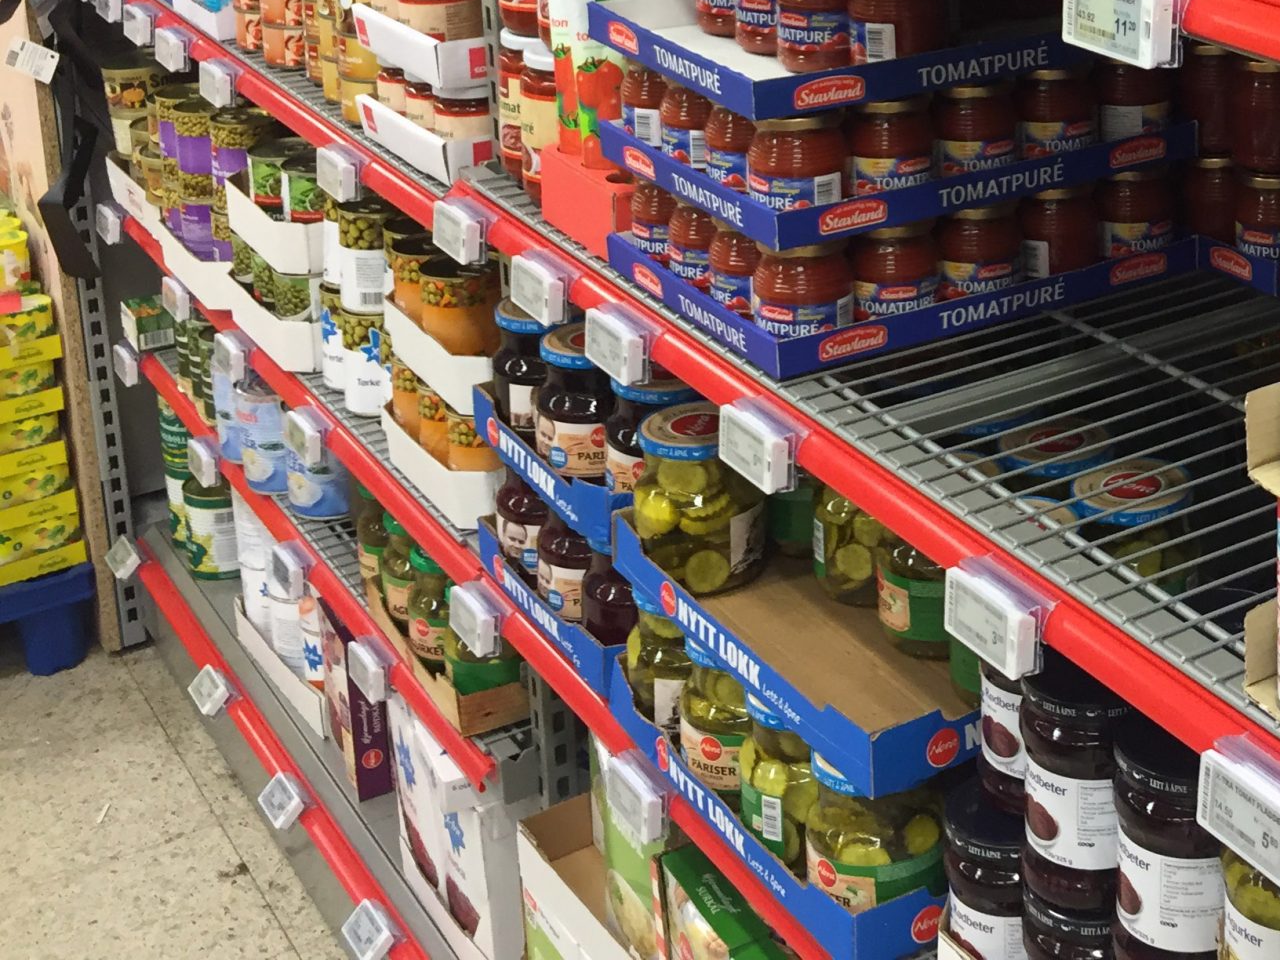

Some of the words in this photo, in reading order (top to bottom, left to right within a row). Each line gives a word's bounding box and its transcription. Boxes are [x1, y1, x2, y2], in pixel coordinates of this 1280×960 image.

[654, 44, 722, 95] TOMATPURÉ
[918, 40, 1050, 87] TOMATPURÉ
[797, 82, 862, 108] Stavland
[672, 172, 744, 228] TOMATPURÉ
[939, 157, 1066, 208] TOMATPURÉ
[821, 206, 886, 233] Stavland
[678, 294, 748, 353] TOMATPURÉ
[939, 281, 1066, 330] TOMATPURÉ
[820, 330, 886, 360] Stavland
[499, 428, 527, 470] NYTT
[526, 454, 555, 501] LOKK
[503, 569, 528, 609] NYTT
[529, 594, 561, 641] LOKK
[678, 597, 717, 649] NYTT
[719, 633, 761, 690] LOKK
[691, 758, 737, 777] PARISER
[669, 756, 705, 810] NYTT
[708, 799, 746, 858] LOKK
